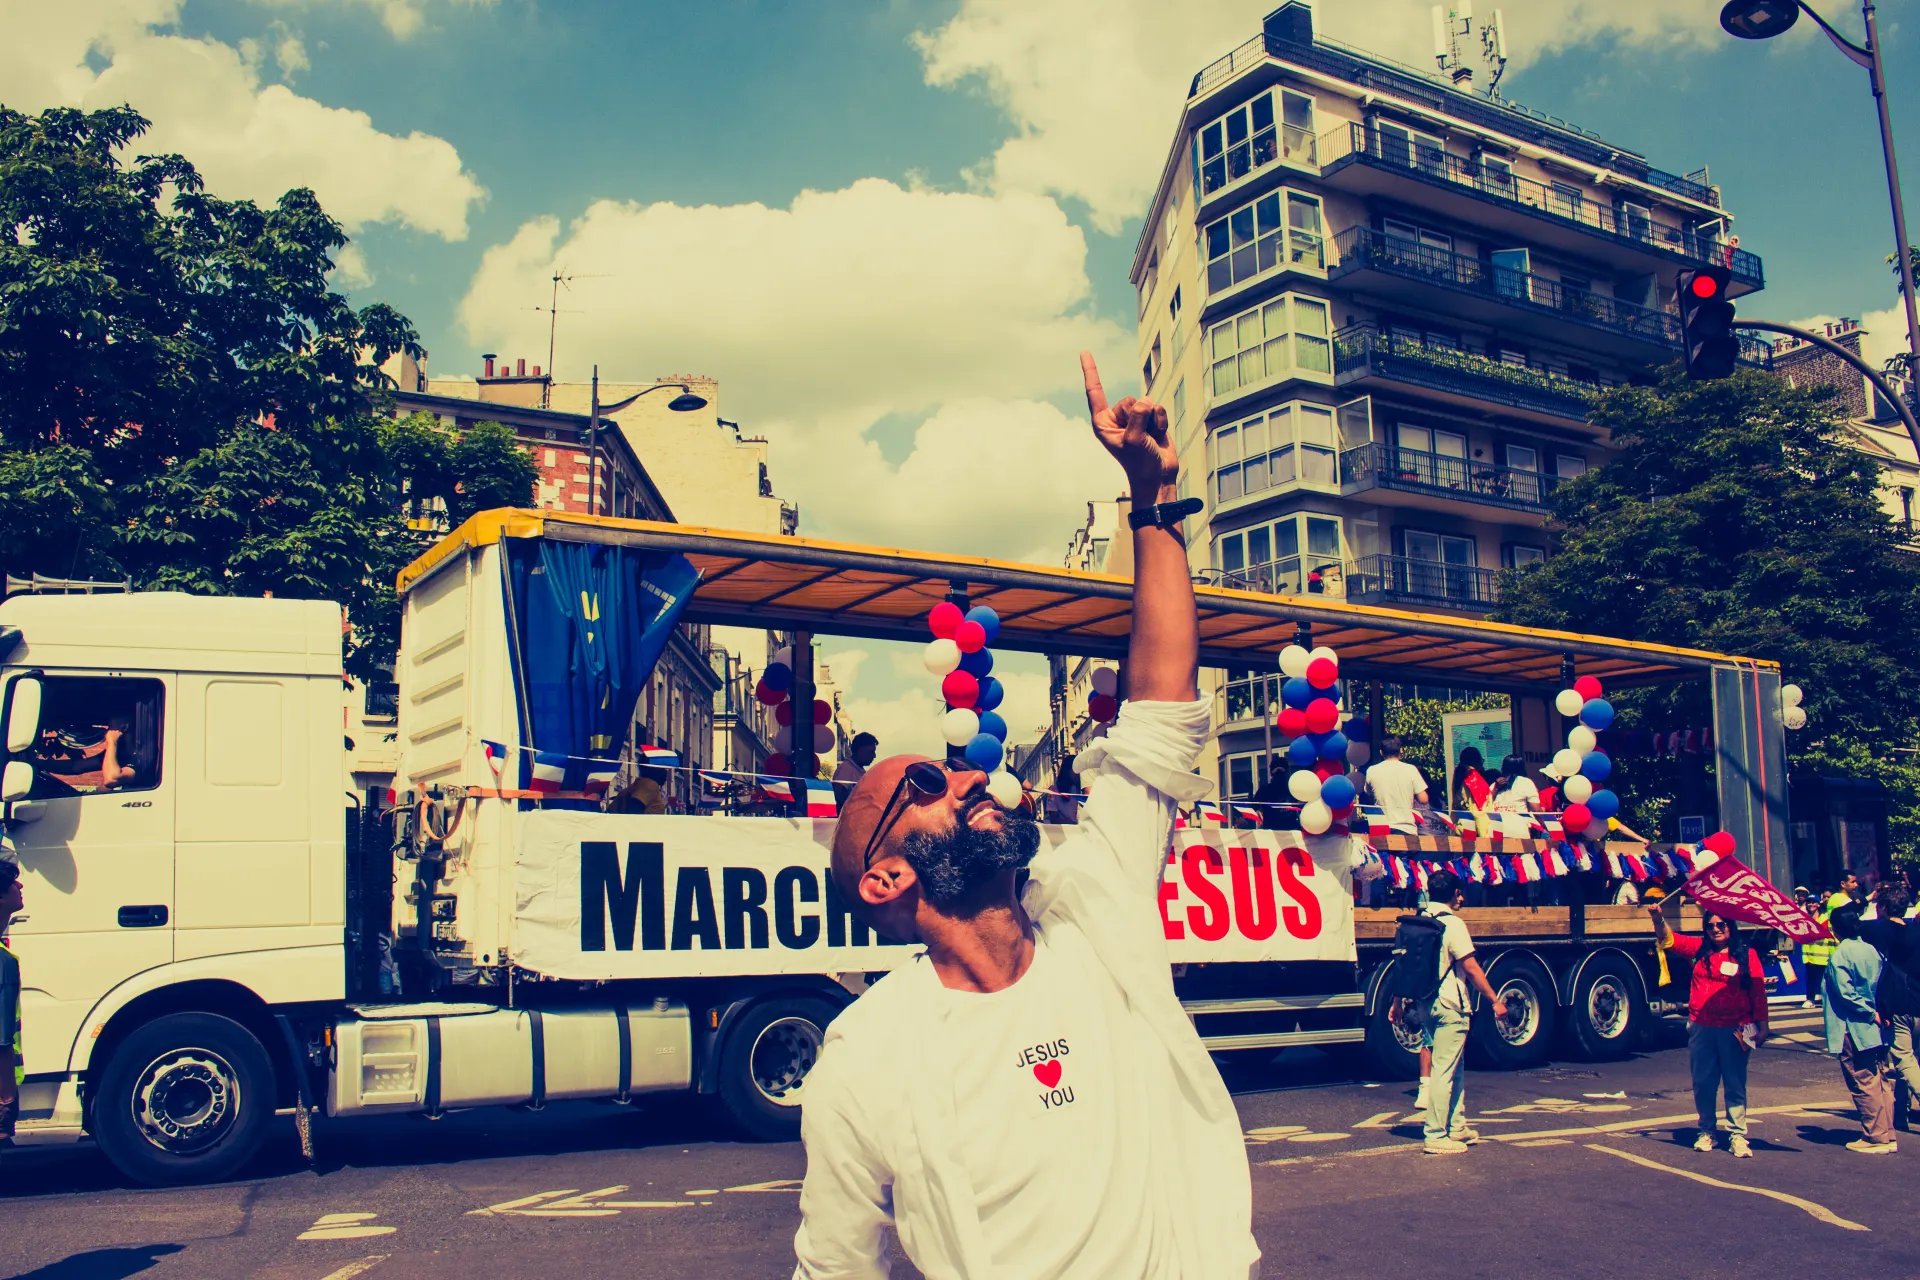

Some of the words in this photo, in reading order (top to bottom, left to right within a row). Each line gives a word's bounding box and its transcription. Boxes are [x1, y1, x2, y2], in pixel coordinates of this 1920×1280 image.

[580, 841, 907, 952] MARCH
[1158, 844, 1323, 942] ESUS
[1708, 869, 1821, 936] JESUS
[1016, 1038, 1070, 1068] JESUS
[1038, 1085, 1075, 1110] YOU
